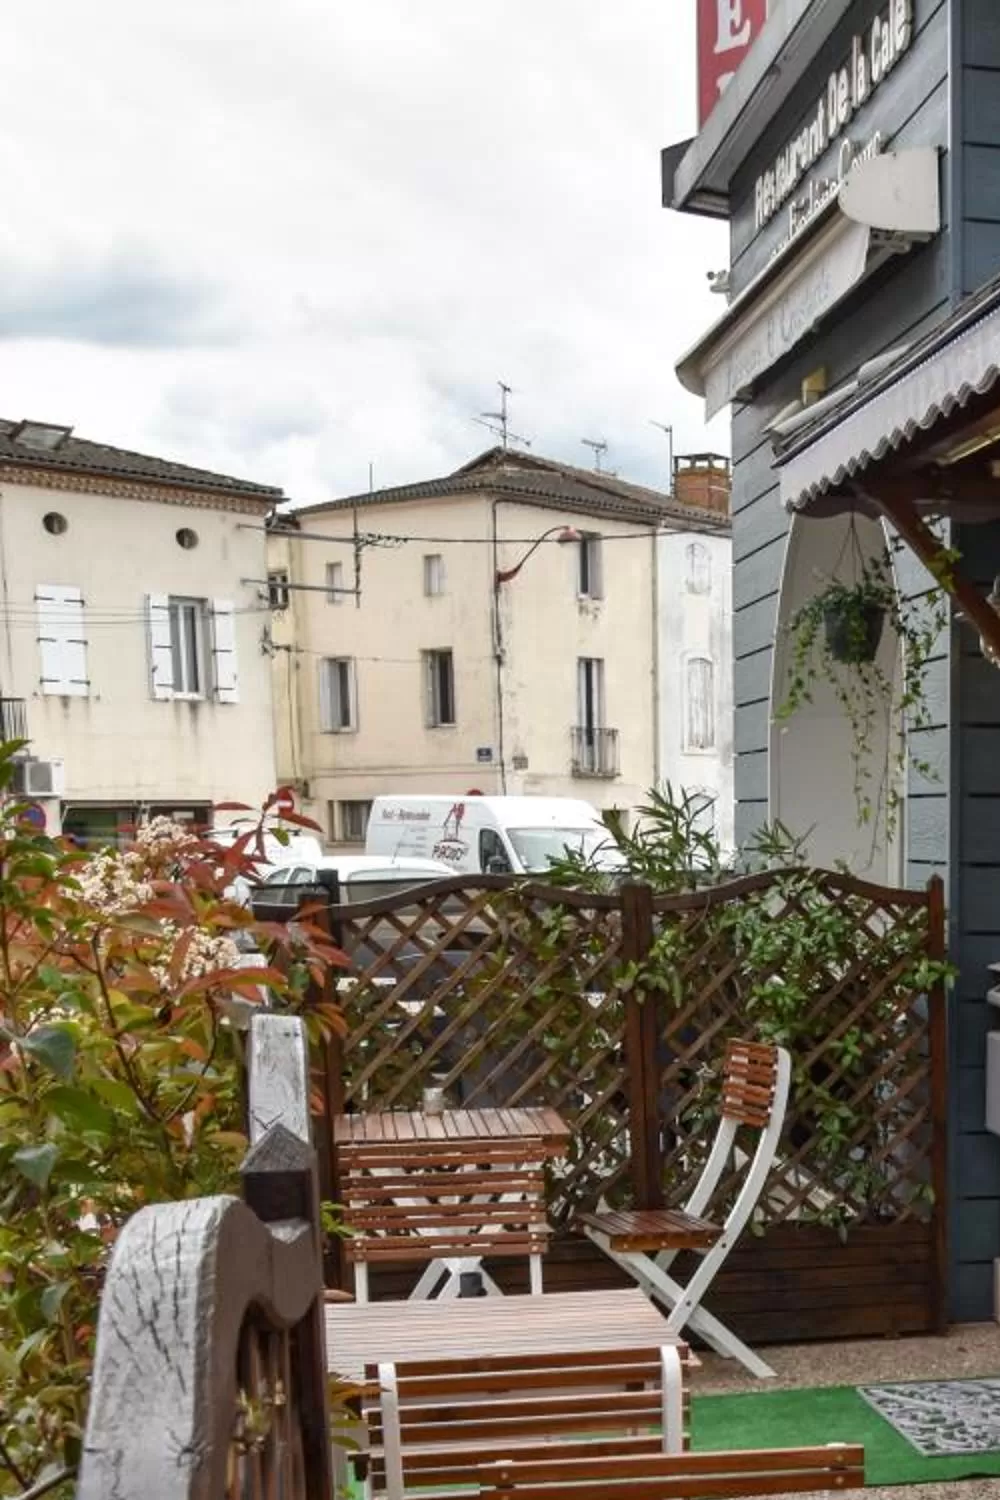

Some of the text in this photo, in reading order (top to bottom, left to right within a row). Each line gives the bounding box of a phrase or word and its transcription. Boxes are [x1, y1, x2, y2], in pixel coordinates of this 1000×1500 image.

[755, 98, 825, 231] Restaurant
[828, 66, 850, 138] De
[853, 35, 868, 108] la
